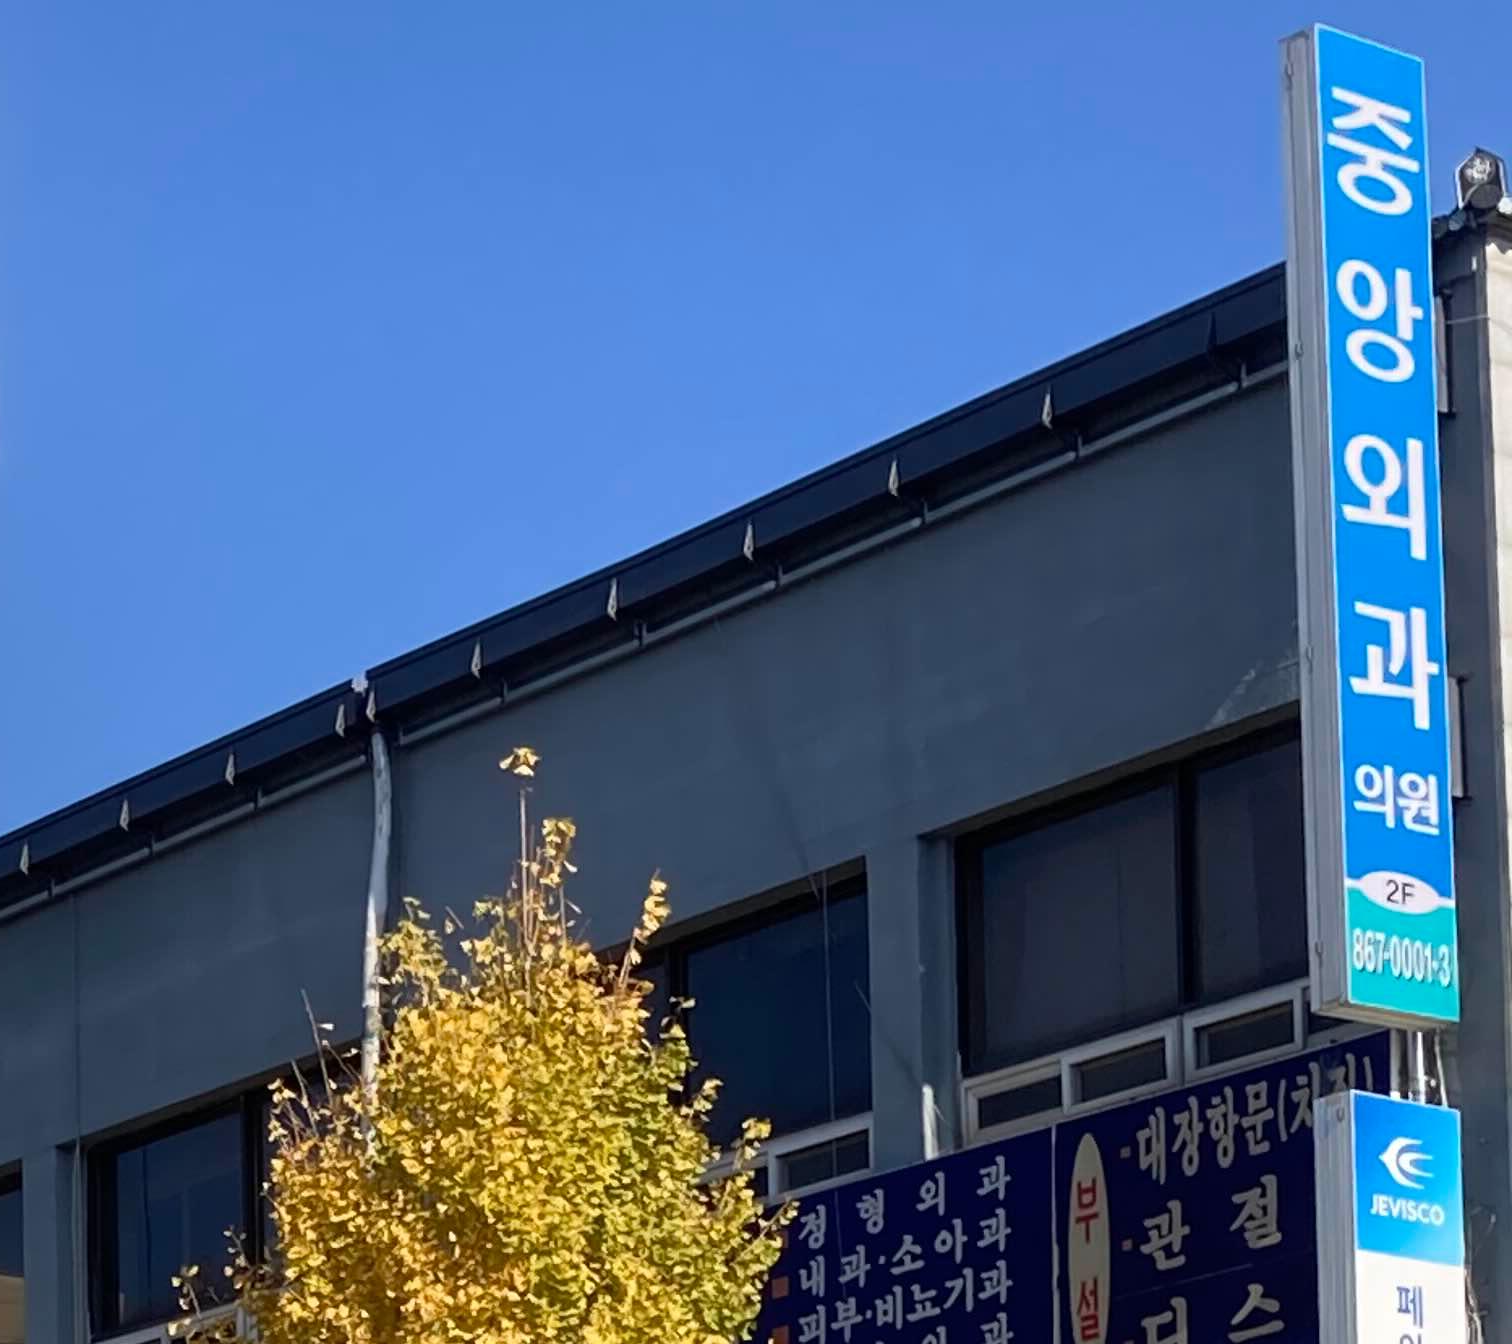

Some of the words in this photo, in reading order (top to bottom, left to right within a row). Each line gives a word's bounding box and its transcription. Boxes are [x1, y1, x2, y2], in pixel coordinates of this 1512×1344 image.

[1325, 86, 1439, 731] 중앙외과
[1353, 763, 1440, 836] 의원
[1386, 879, 1415, 905] 2F
[798, 1155, 1012, 1250] 정형외과
[1140, 1174, 1282, 1271] 관절
[1370, 1193, 1445, 1226] JEVISCO
[1075, 1177, 1100, 1342] 부설
